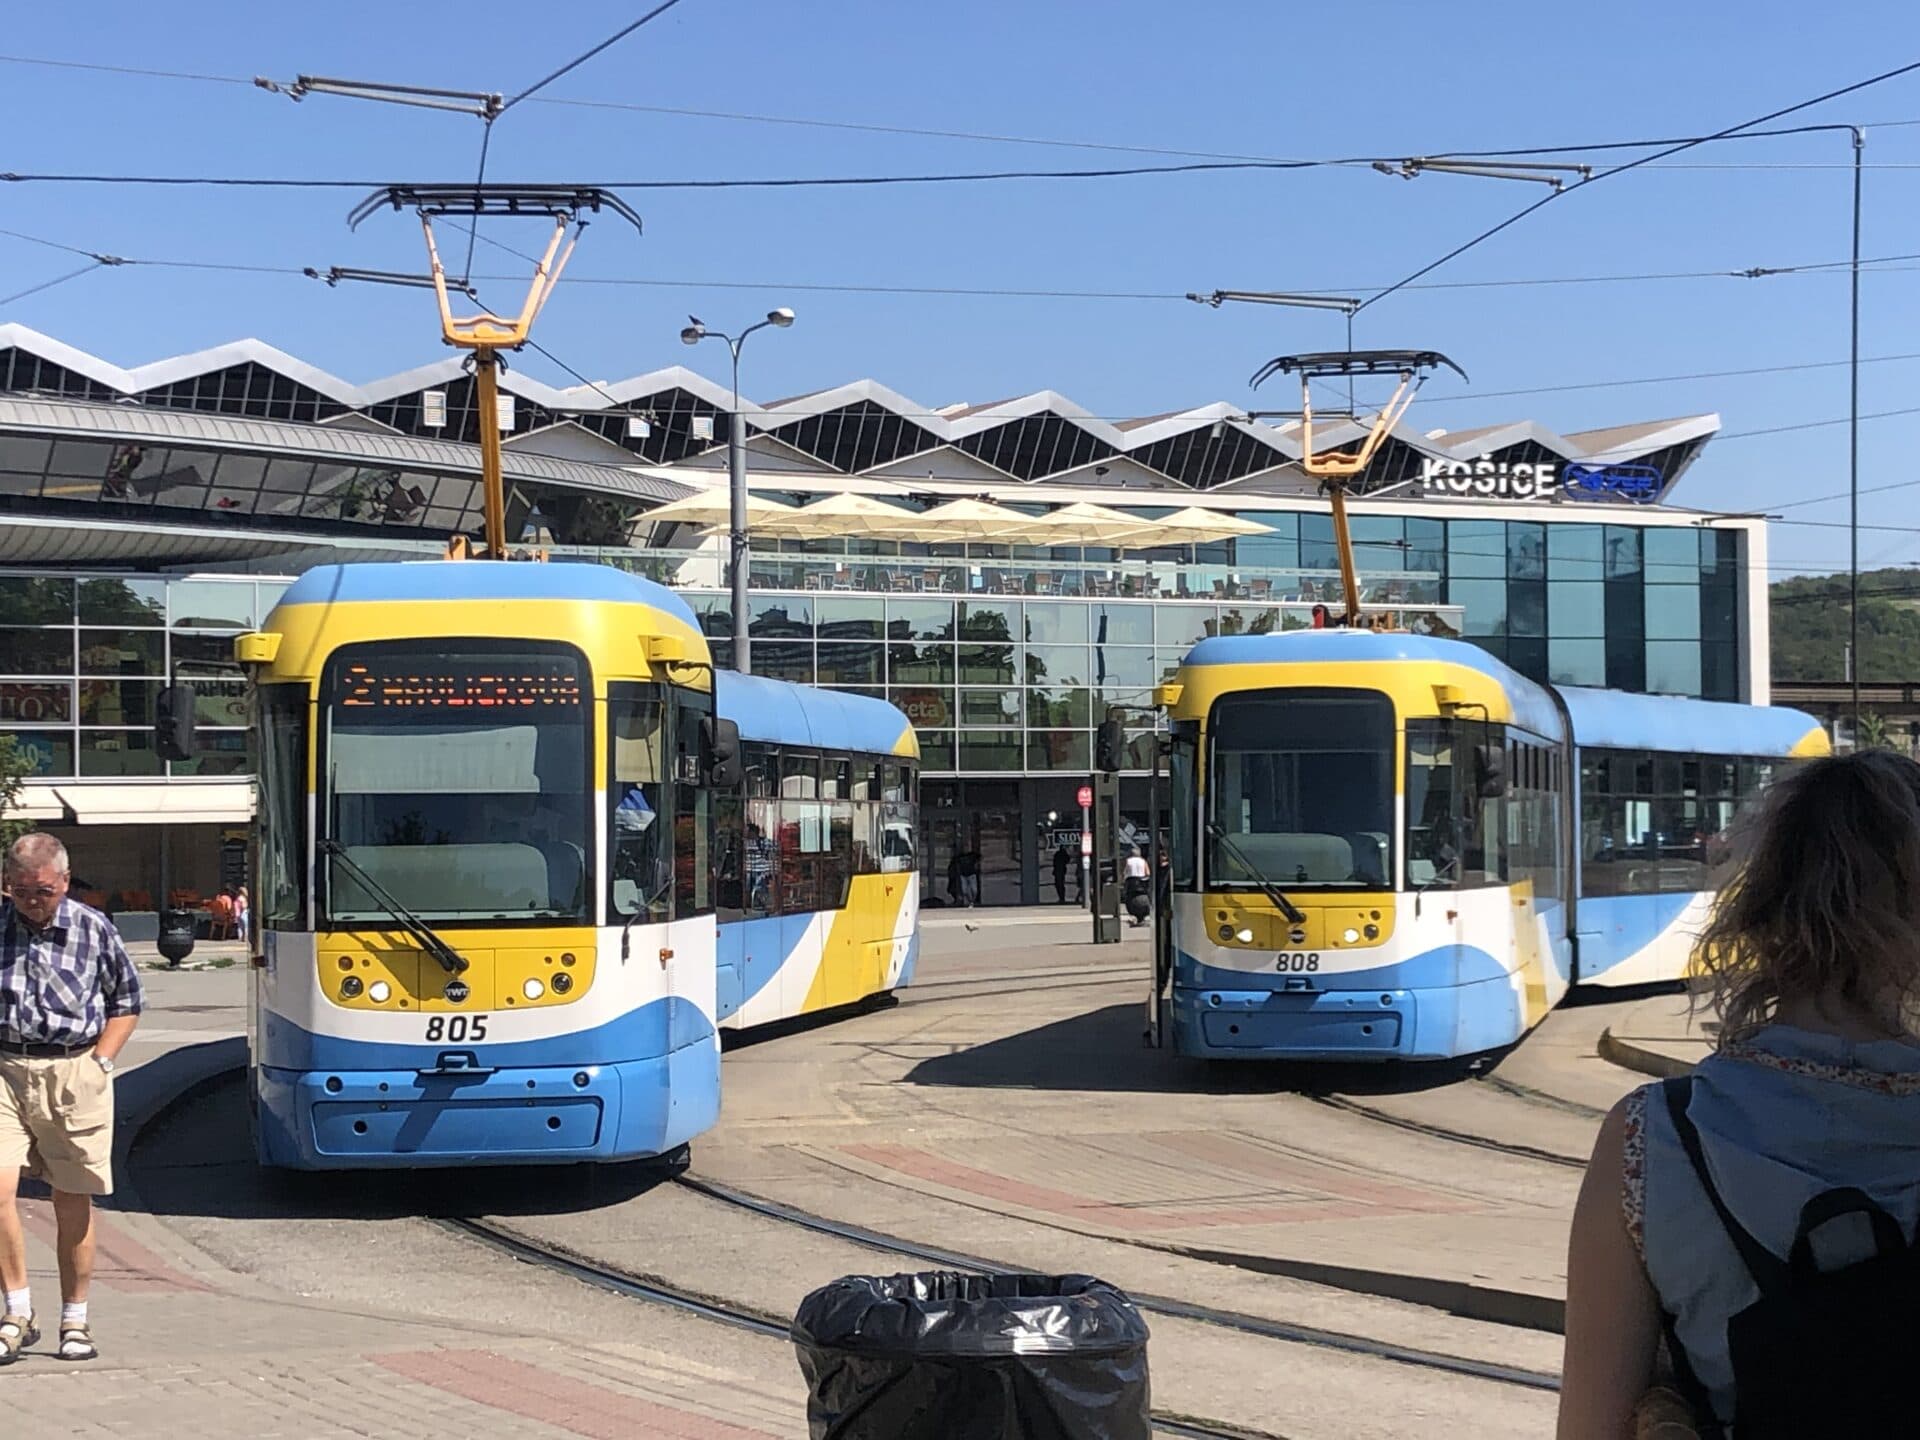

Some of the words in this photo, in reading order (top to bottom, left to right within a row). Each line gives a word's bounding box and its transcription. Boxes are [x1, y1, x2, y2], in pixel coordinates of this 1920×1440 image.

[1423, 453, 1556, 495] KOŠICE
[1276, 953, 1320, 972] 808
[425, 1014, 488, 1043] 805
